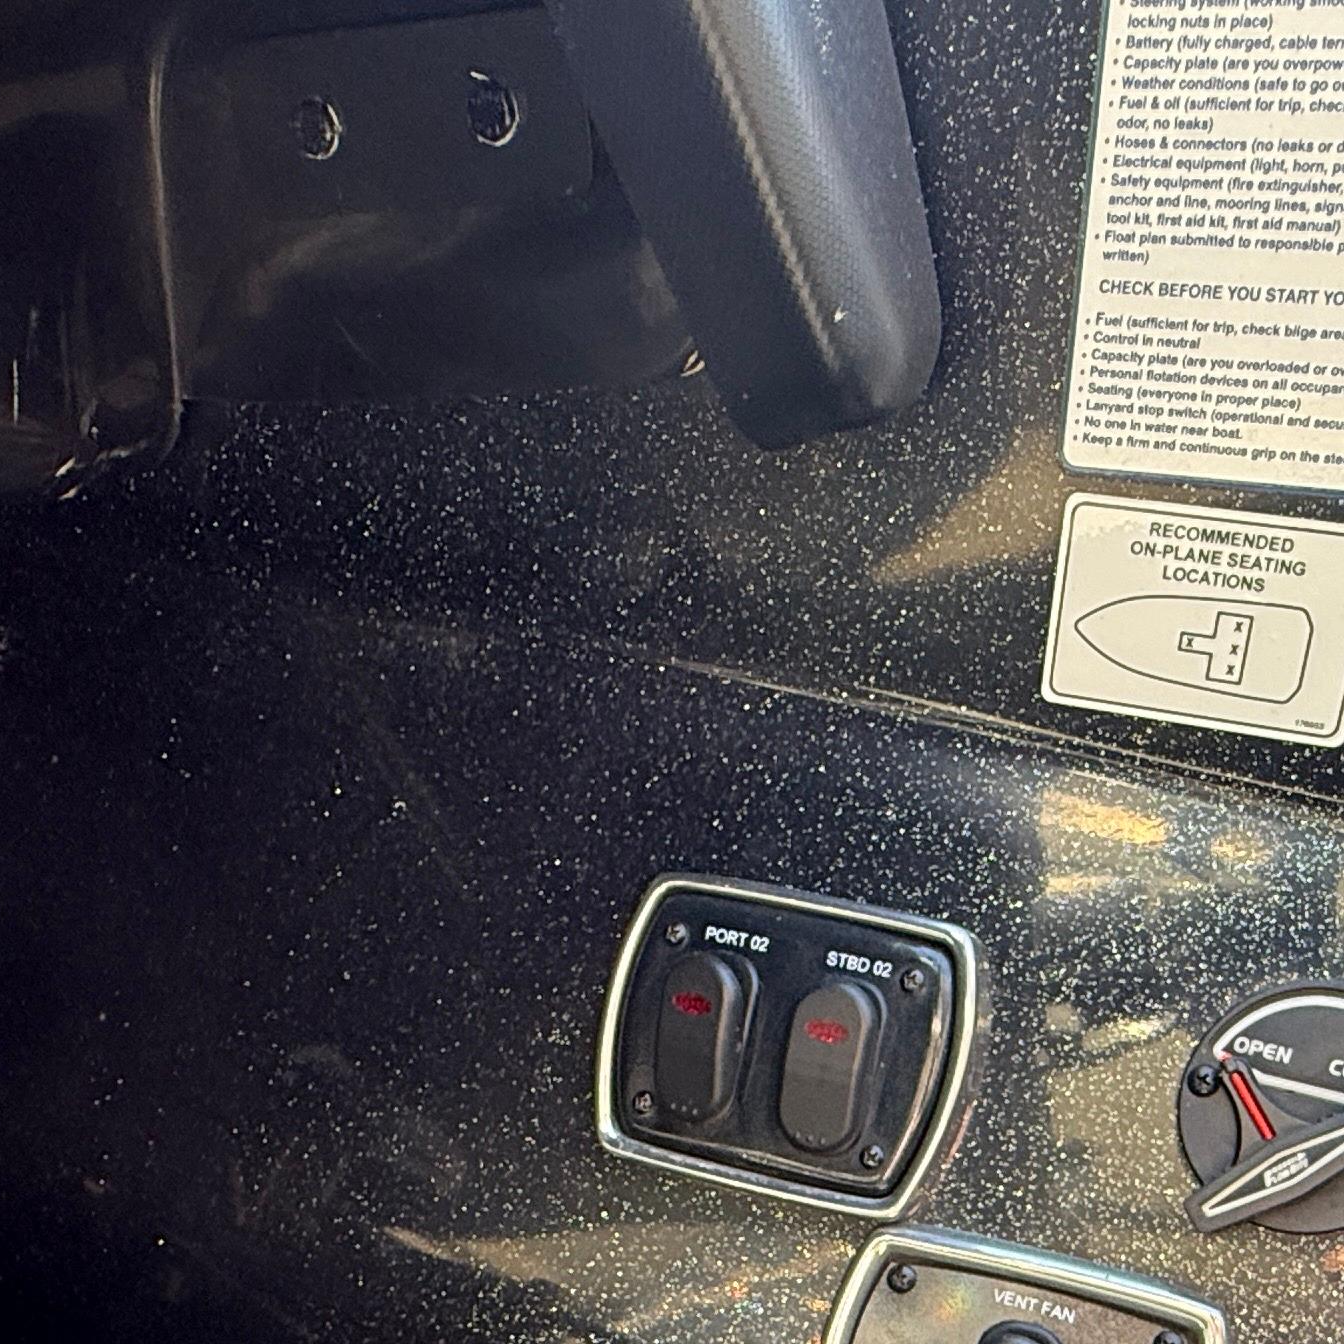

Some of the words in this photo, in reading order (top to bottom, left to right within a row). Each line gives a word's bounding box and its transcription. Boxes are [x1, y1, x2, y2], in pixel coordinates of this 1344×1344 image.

[1099, 279, 1154, 295] CHECK
[1158, 282, 1222, 299] BEFORE
[1227, 285, 1261, 301] YOU
[1265, 287, 1319, 304] START
[1082, 432, 1112, 447] Keep
[1115, 436, 1122, 446] a
[1126, 435, 1149, 448] firm
[1153, 439, 1176, 451] and
[1179, 442, 1247, 456] continuous
[1251, 447, 1276, 461] grip
[1279, 450, 1296, 460] on
[1299, 450, 1319, 463] the
[1149, 522, 1294, 552] RECOMMENDED
[1130, 540, 1222, 565] ON-PLANE
[1226, 552, 1305, 576] SEATING
[1162, 565, 1264, 592] LOCATIONS
[705, 926, 750, 948] PORT
[750, 935, 770, 952] 02
[826, 951, 870, 974] STBD
[873, 960, 893, 978] 02
[1233, 1036, 1293, 1065] OPEN
[994, 1288, 1039, 1312] VENT
[1040, 1301, 1076, 1324] FAN
